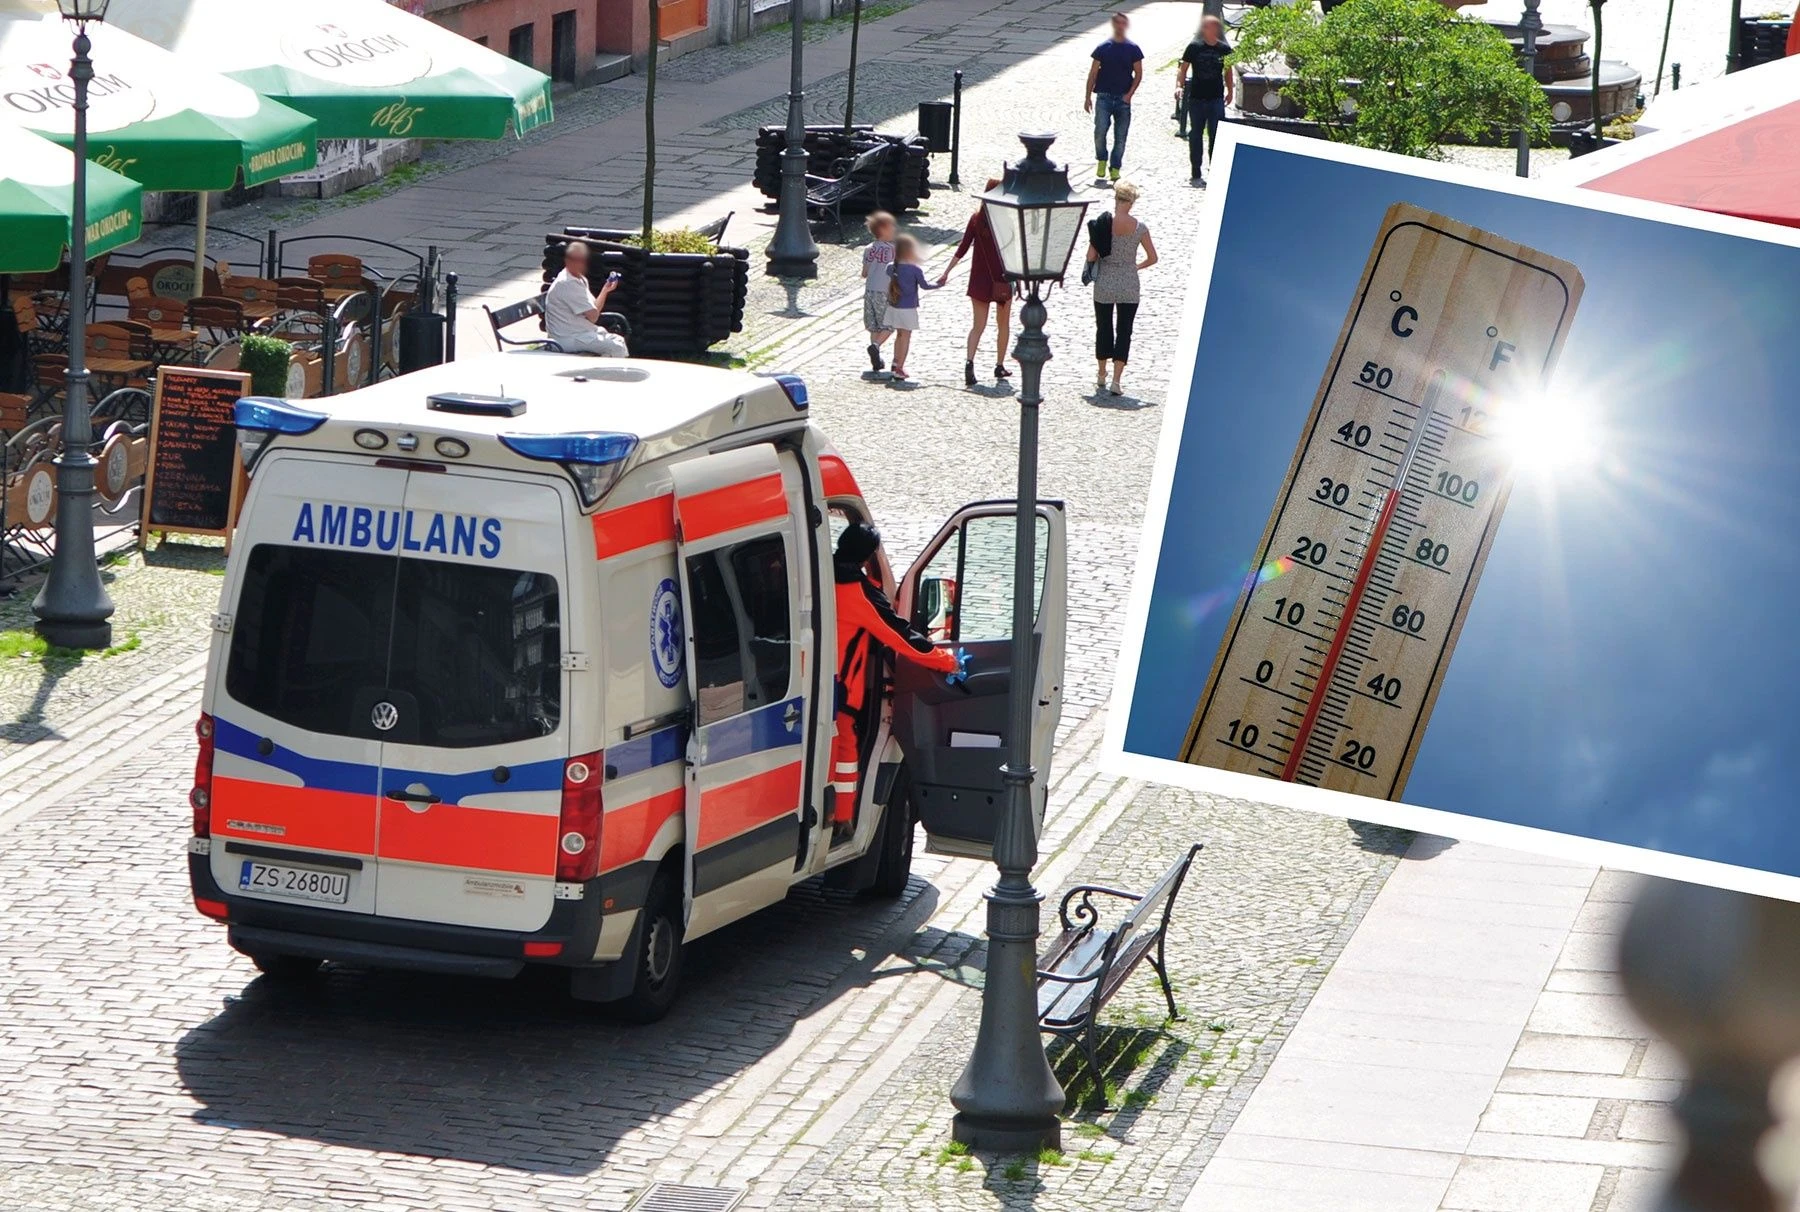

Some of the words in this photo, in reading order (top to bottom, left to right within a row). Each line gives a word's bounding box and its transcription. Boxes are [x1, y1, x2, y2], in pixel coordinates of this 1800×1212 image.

[303, 34, 409, 68] OKOCIM
[370, 95, 425, 135] 1845
[1359, 361, 1393, 389] 50
[1337, 420, 1372, 447] 40
[1315, 477, 1350, 506] 30
[1438, 471, 1479, 503] 100
[292, 502, 502, 560] AMBULANS
[1291, 536, 1327, 565] 20
[1415, 538, 1450, 566] 80
[1275, 597, 1305, 626] 10
[1391, 605, 1425, 633] 60
[1255, 660, 1274, 684] 0
[1366, 673, 1401, 701] 40
[1228, 719, 1259, 748] 10
[1340, 739, 1376, 769] 20
[253, 865, 280, 888] ZS
[285, 870, 344, 896] 2680U
